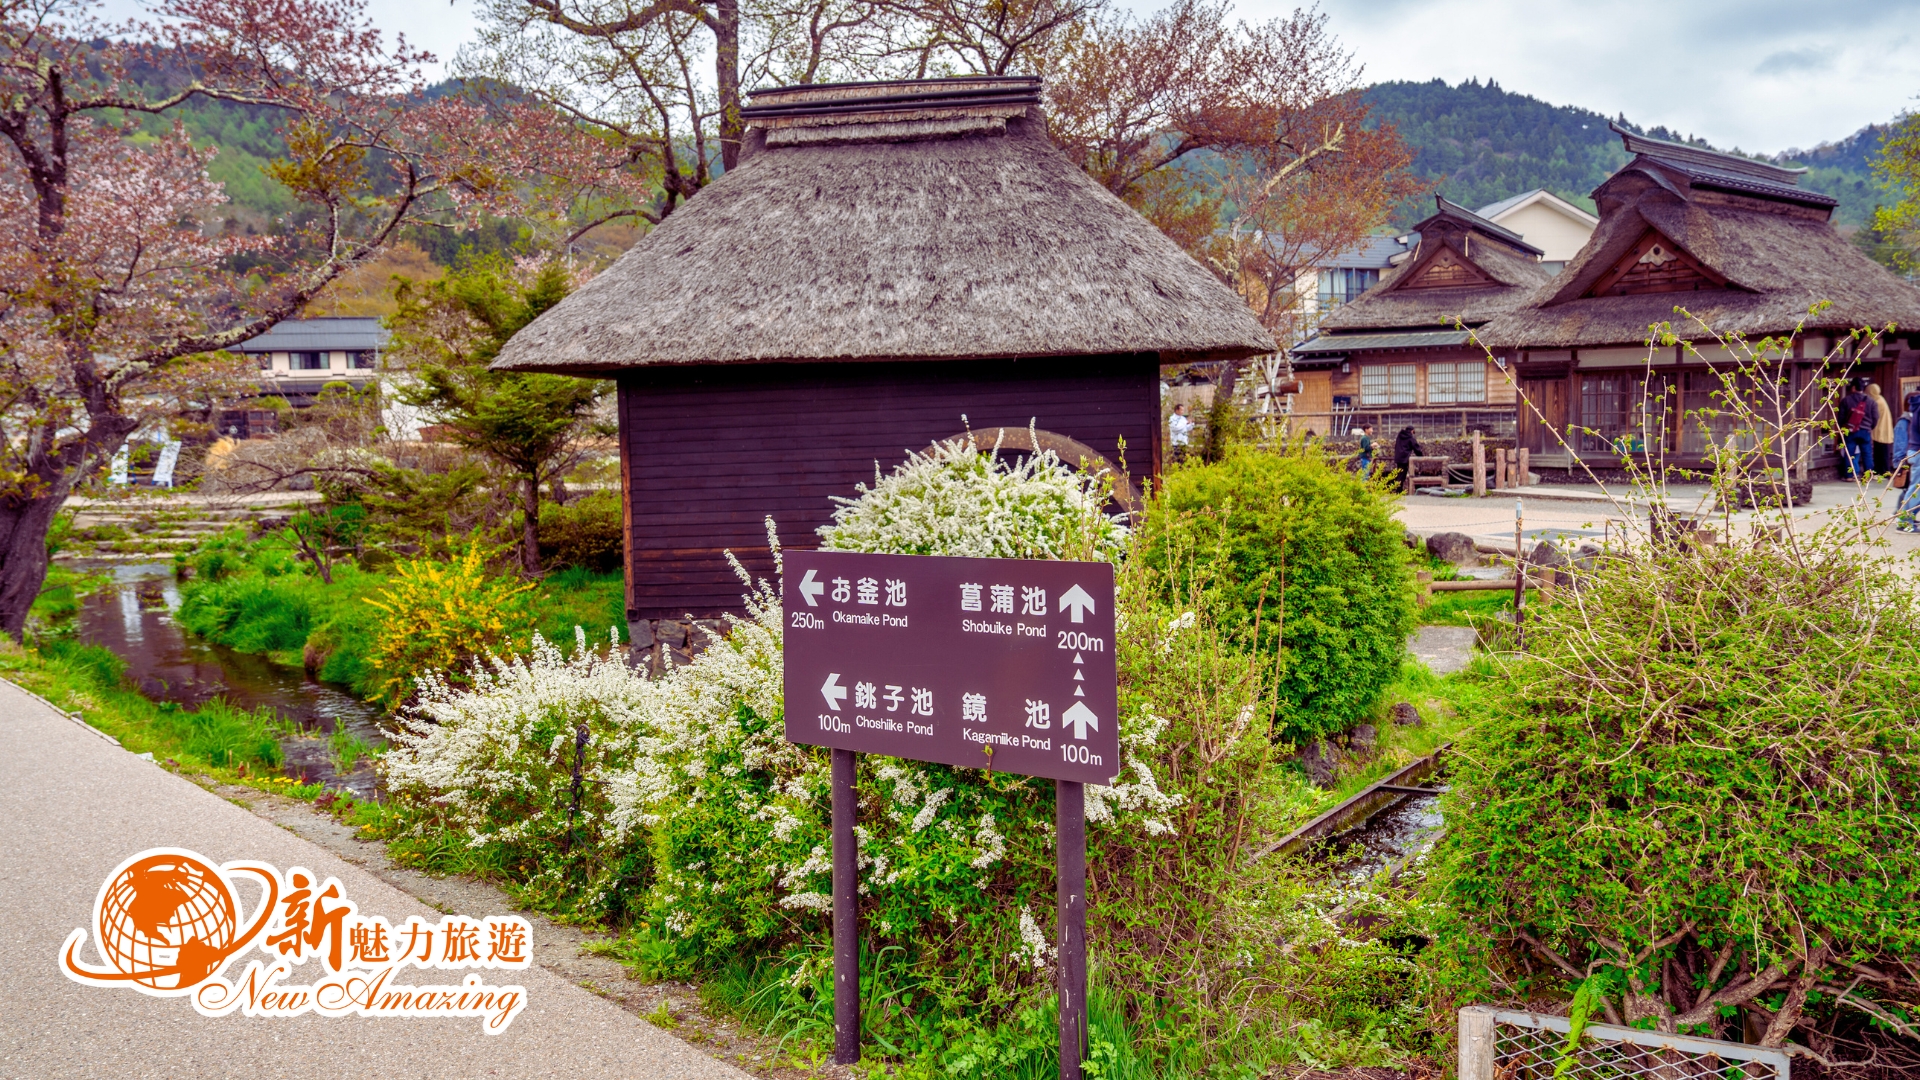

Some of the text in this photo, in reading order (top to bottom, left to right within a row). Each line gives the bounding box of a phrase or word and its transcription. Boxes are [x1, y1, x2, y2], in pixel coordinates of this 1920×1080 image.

[831, 576, 908, 607] お釜池
[959, 582, 1047, 616] 菖蒲池
[791, 611, 825, 630] 250m
[832, 610, 908, 628] Okamaike Pond
[961, 618, 1047, 638] Shobuike Pond
[1057, 631, 1104, 653] 200m
[854, 681, 934, 717] 銚子池
[817, 713, 851, 734] 100m
[855, 715, 934, 737] Choshiike Pond
[962, 727, 1051, 751] Kagamiike Pond
[1059, 743, 1103, 767] 100m
